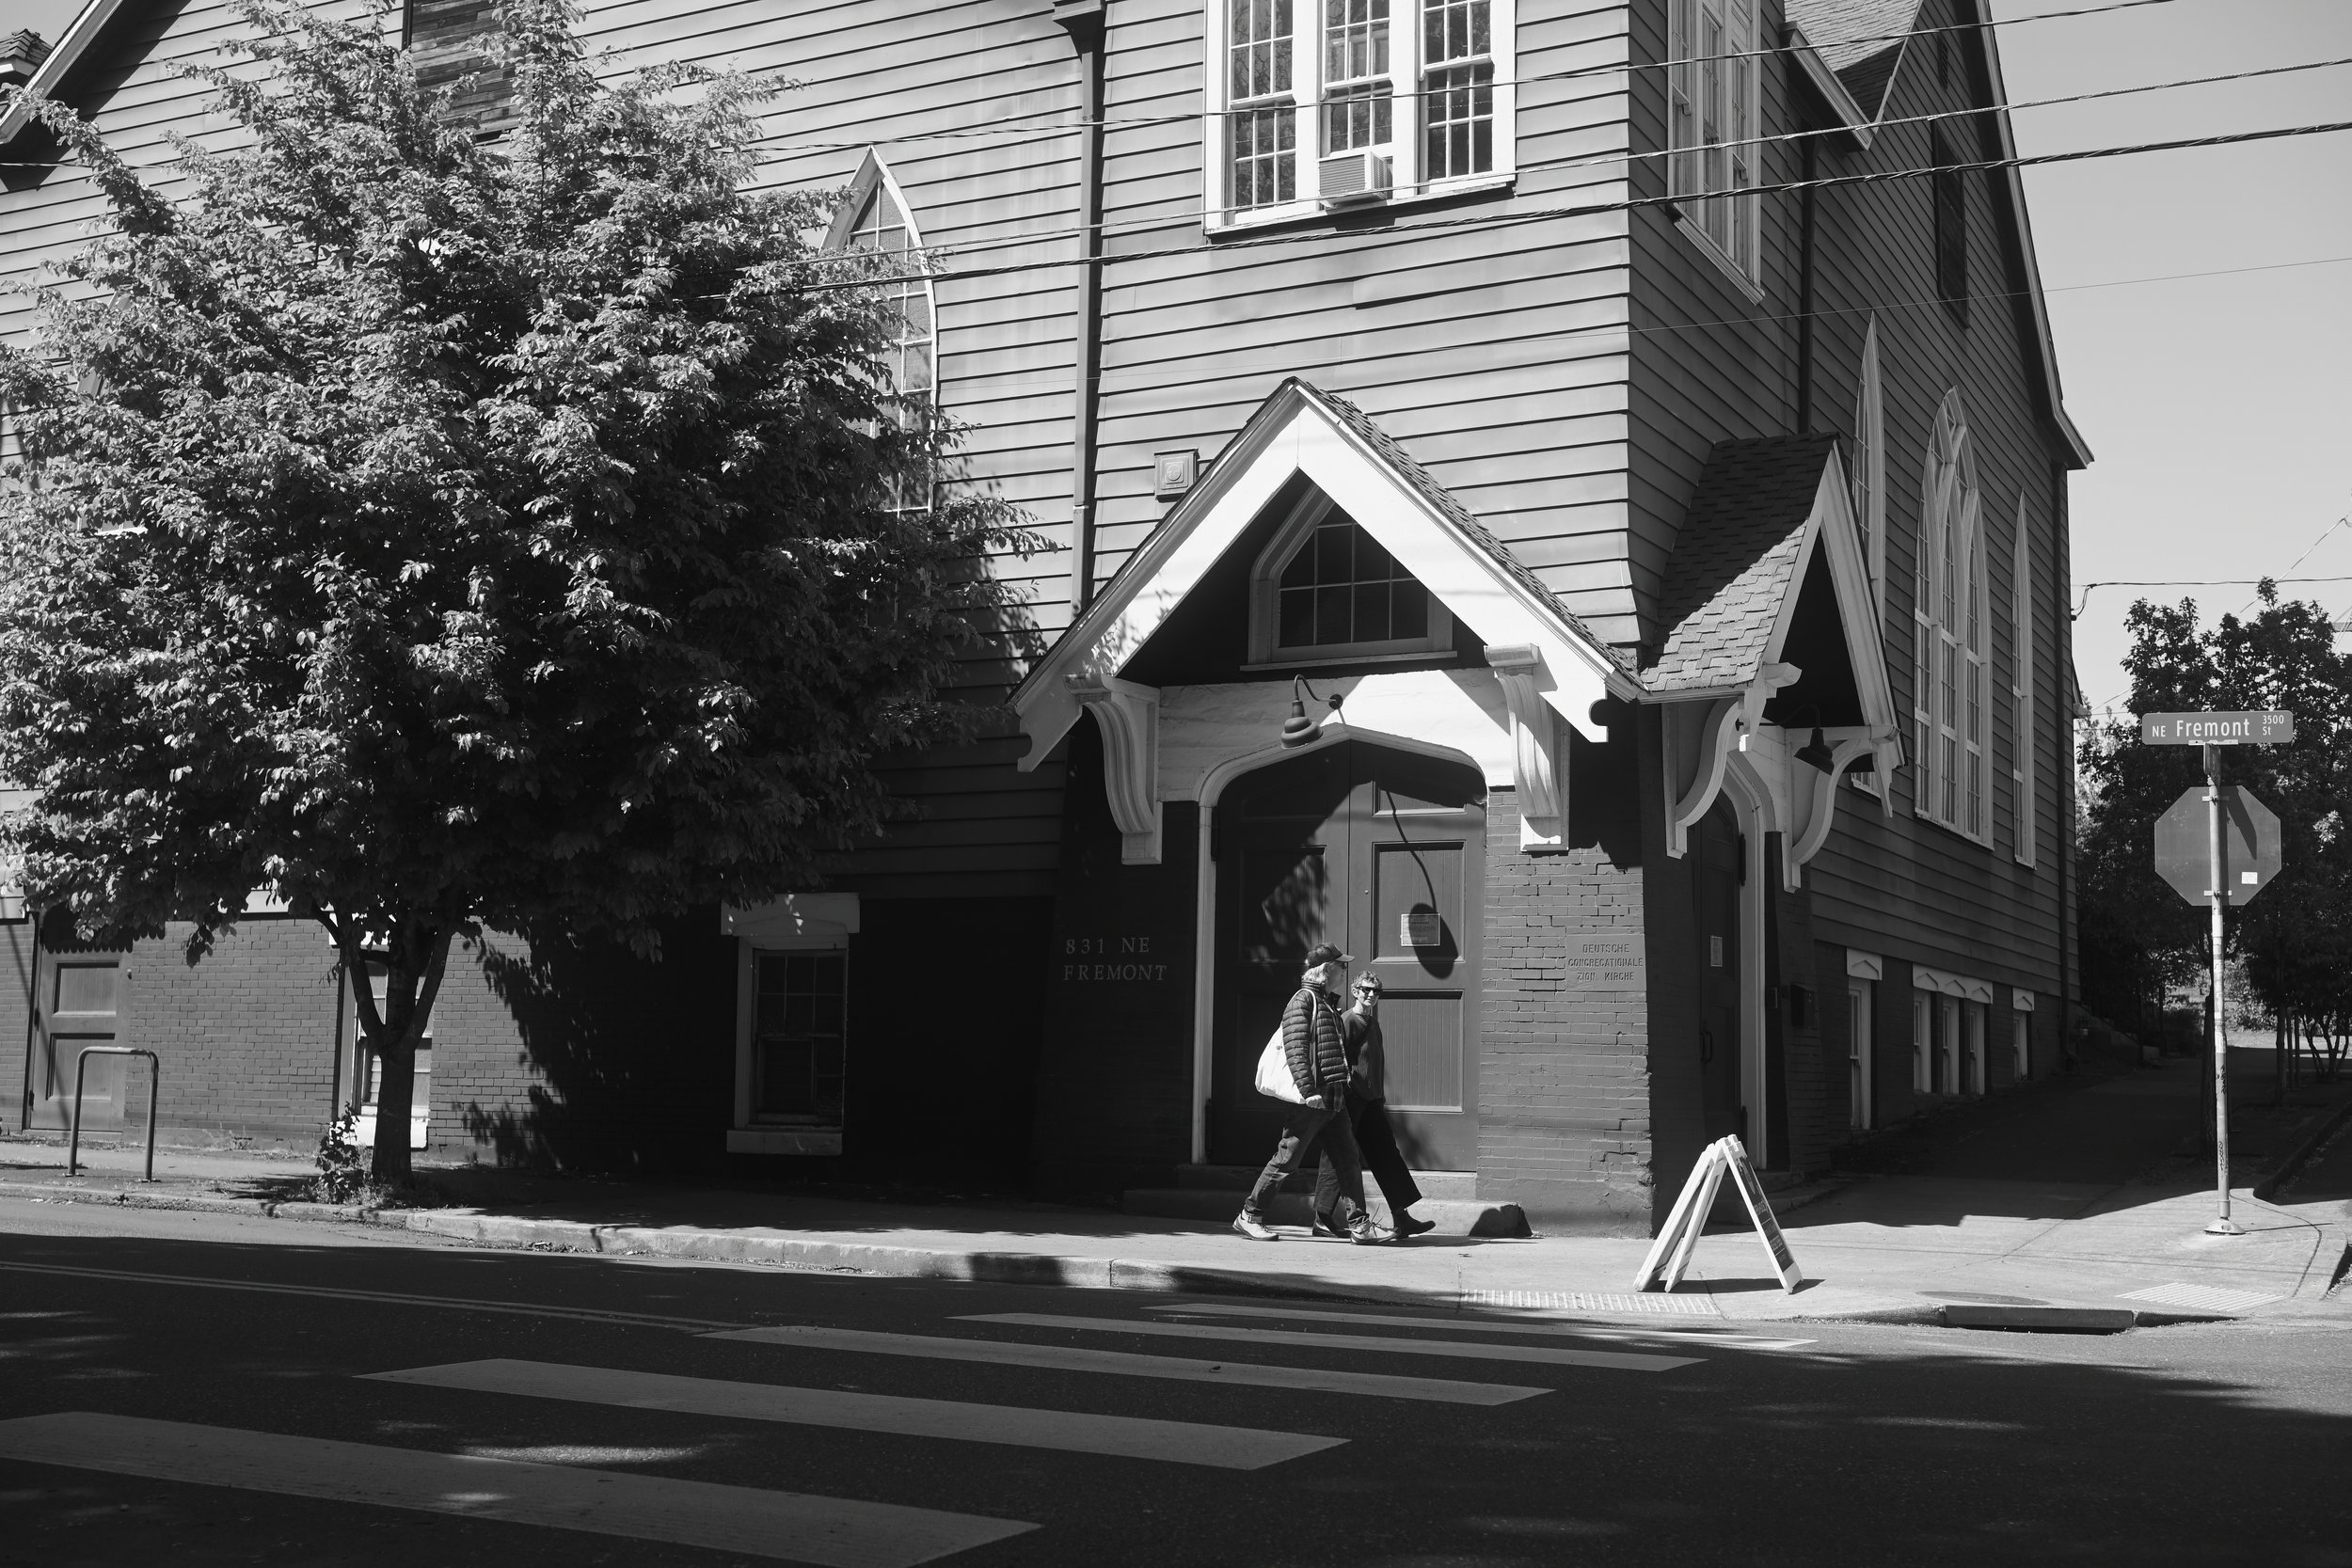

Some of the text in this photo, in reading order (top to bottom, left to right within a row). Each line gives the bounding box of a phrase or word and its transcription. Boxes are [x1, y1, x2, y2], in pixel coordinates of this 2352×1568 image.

[2263, 715, 2284, 724] 3500
[2152, 719, 2272, 737] NE Fremont St
[1066, 937, 1150, 955] 831 NE
[1582, 943, 1630, 953] DEUTSCHE
[1063, 964, 1168, 981] FREMONT
[1577, 972, 1634, 981] ZION KIRCHE
